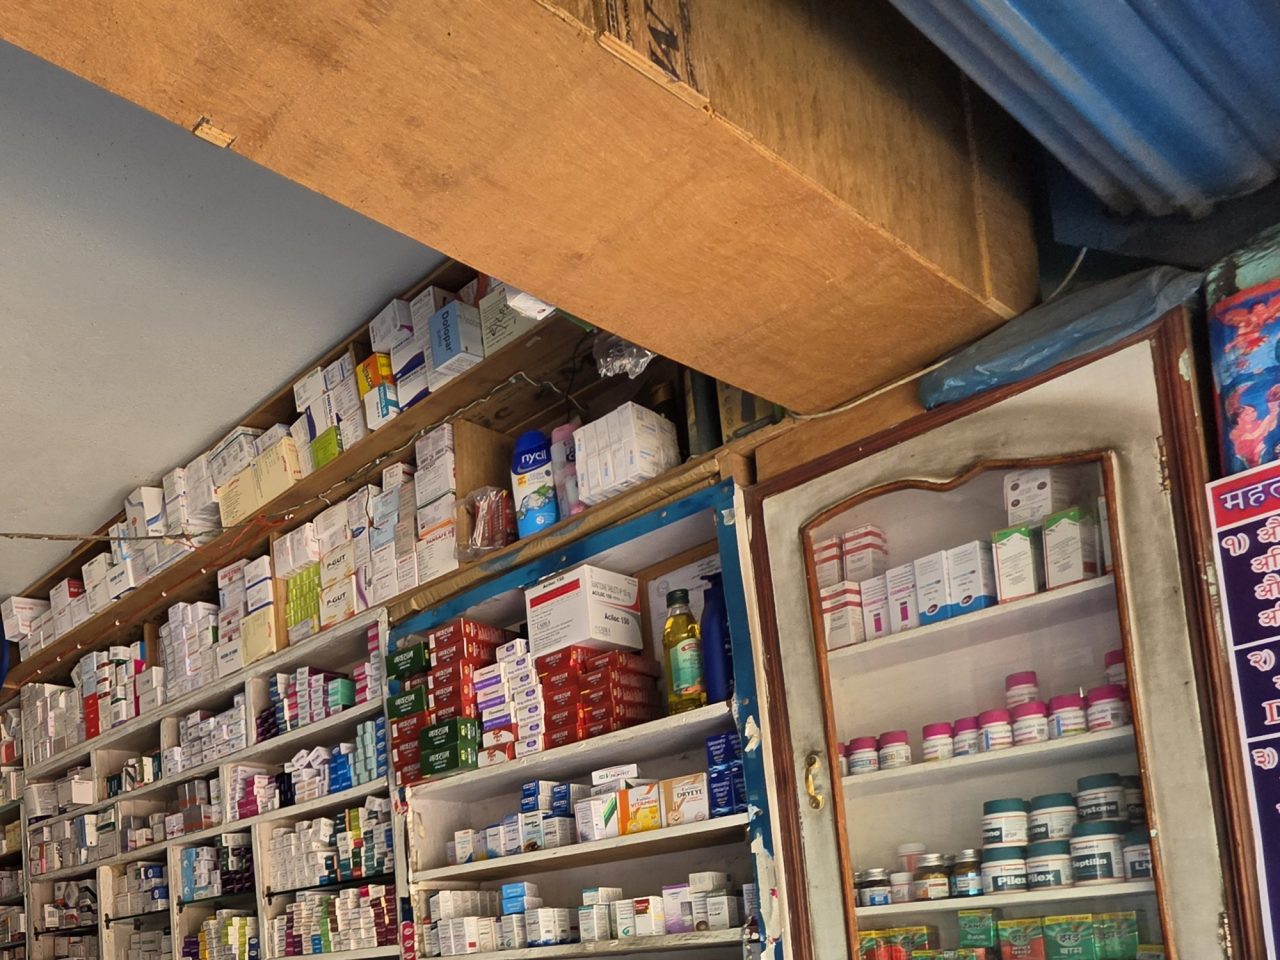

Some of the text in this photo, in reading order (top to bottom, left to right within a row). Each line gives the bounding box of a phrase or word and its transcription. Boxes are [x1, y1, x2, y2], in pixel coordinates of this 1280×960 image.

[521, 448, 548, 467] nycil
[604, 612, 631, 625] Aciloc 150
